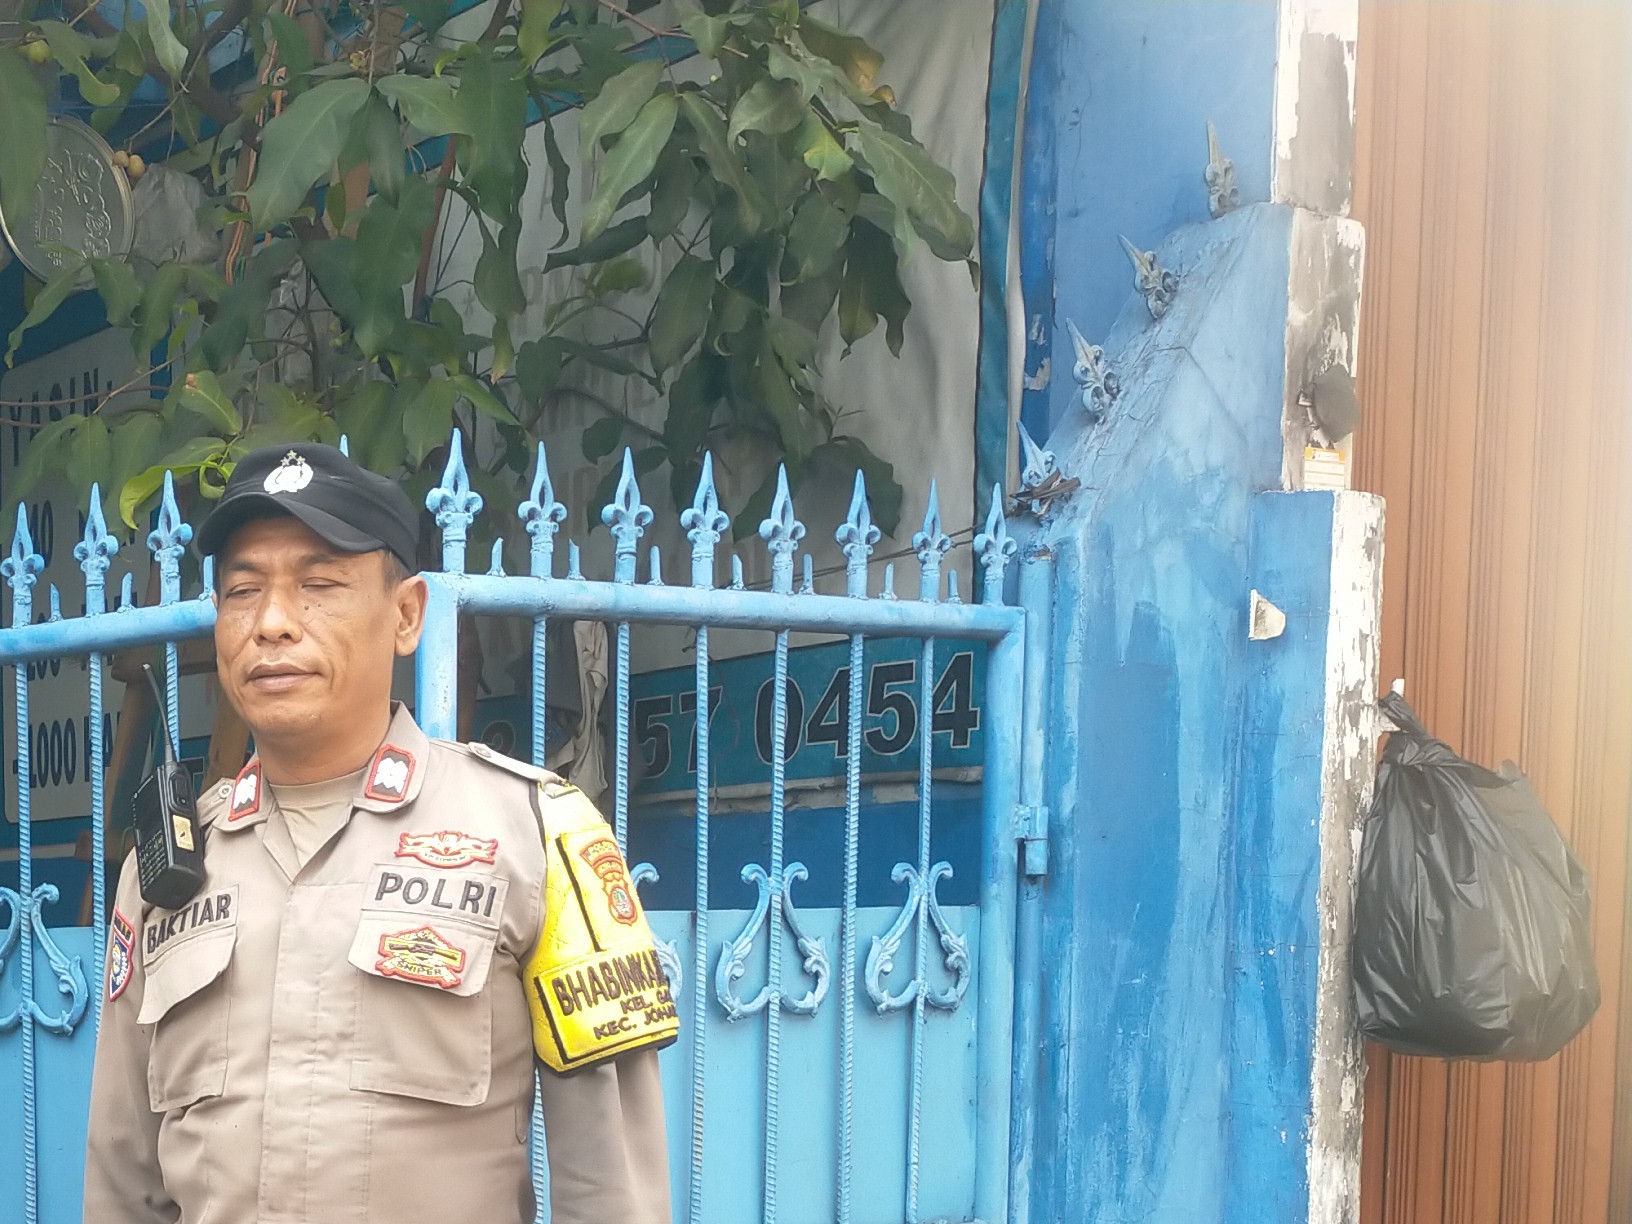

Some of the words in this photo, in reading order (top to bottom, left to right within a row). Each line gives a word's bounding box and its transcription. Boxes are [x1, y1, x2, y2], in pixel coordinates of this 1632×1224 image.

[754, 652, 980, 767] 0454
[375, 872, 497, 917] POLRI
[147, 893, 231, 954] BAKTIAR
[397, 961, 443, 976] SNIPER
[620, 994, 654, 1014] KEL.
[593, 1016, 638, 1040] KEC.
